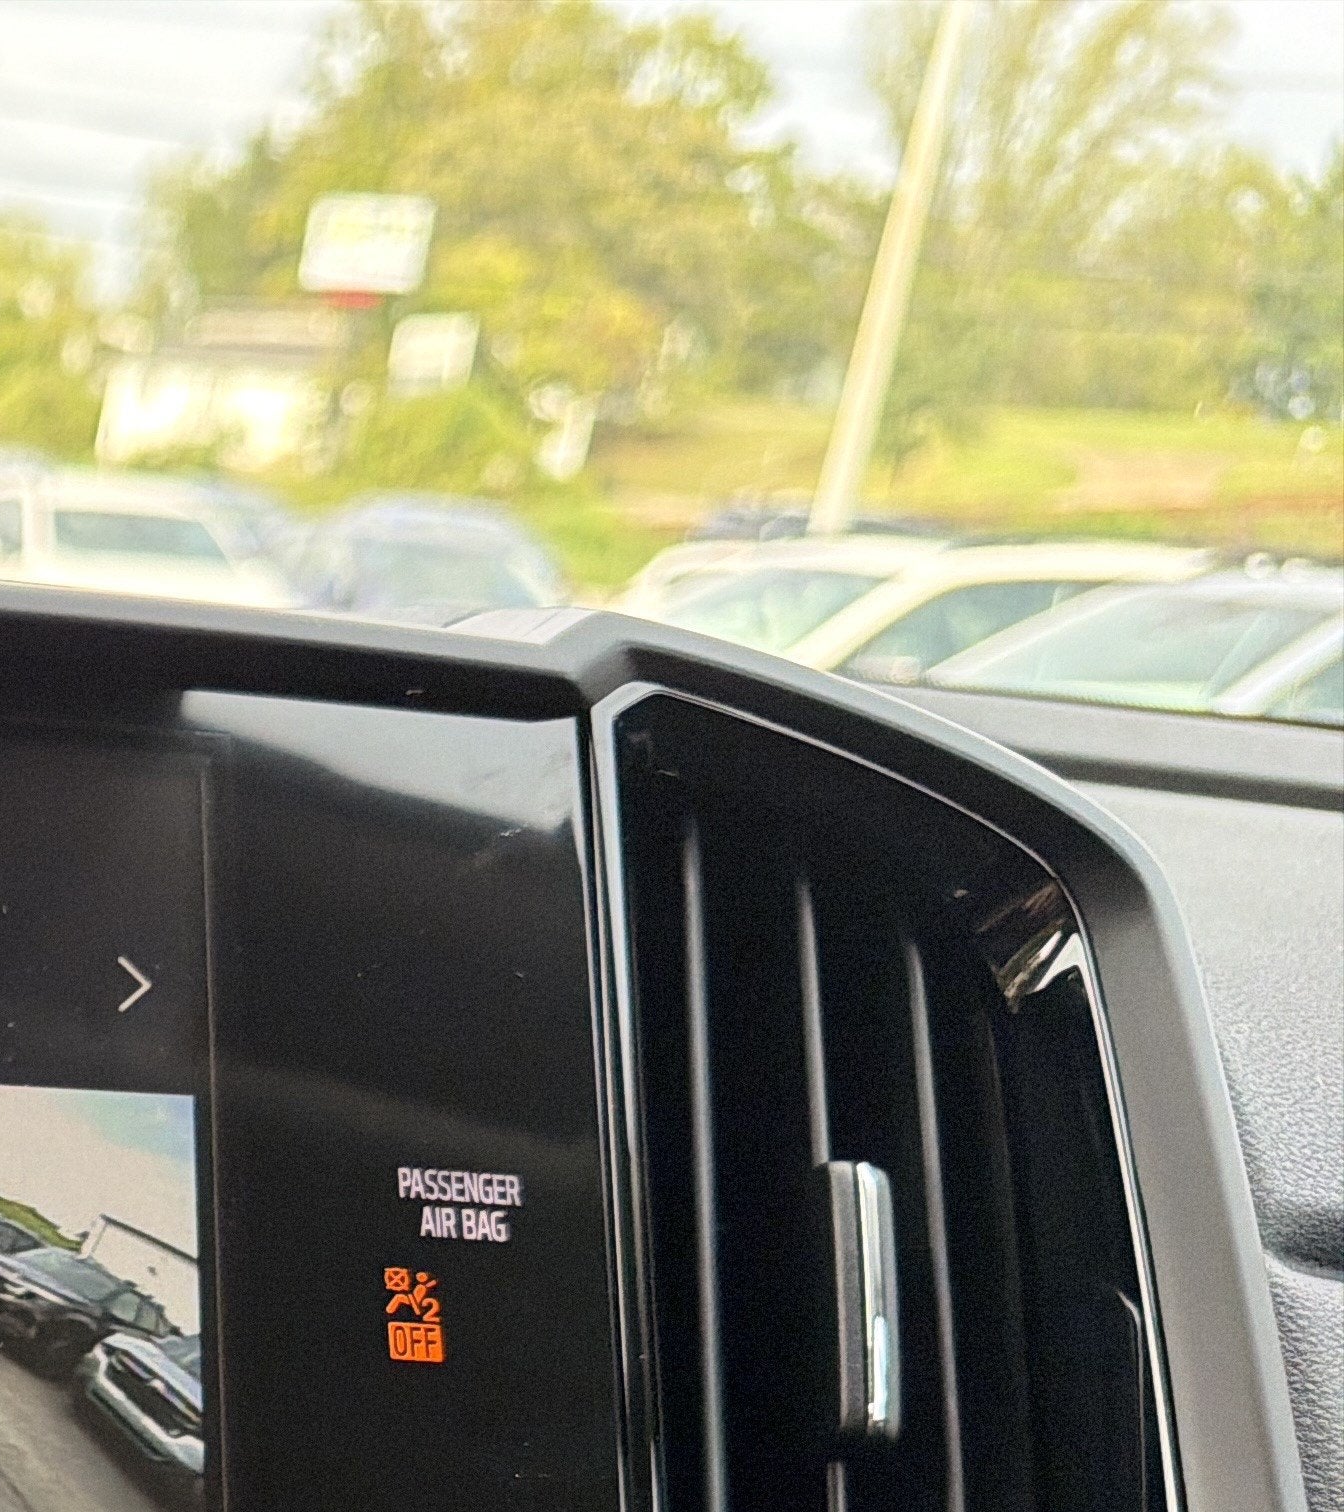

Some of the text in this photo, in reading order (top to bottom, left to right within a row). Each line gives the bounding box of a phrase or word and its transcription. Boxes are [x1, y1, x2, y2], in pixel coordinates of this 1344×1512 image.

[398, 1167, 521, 1206] PASSENGER
[420, 1206, 509, 1242] AIR BAG
[392, 1326, 439, 1358] OFF
